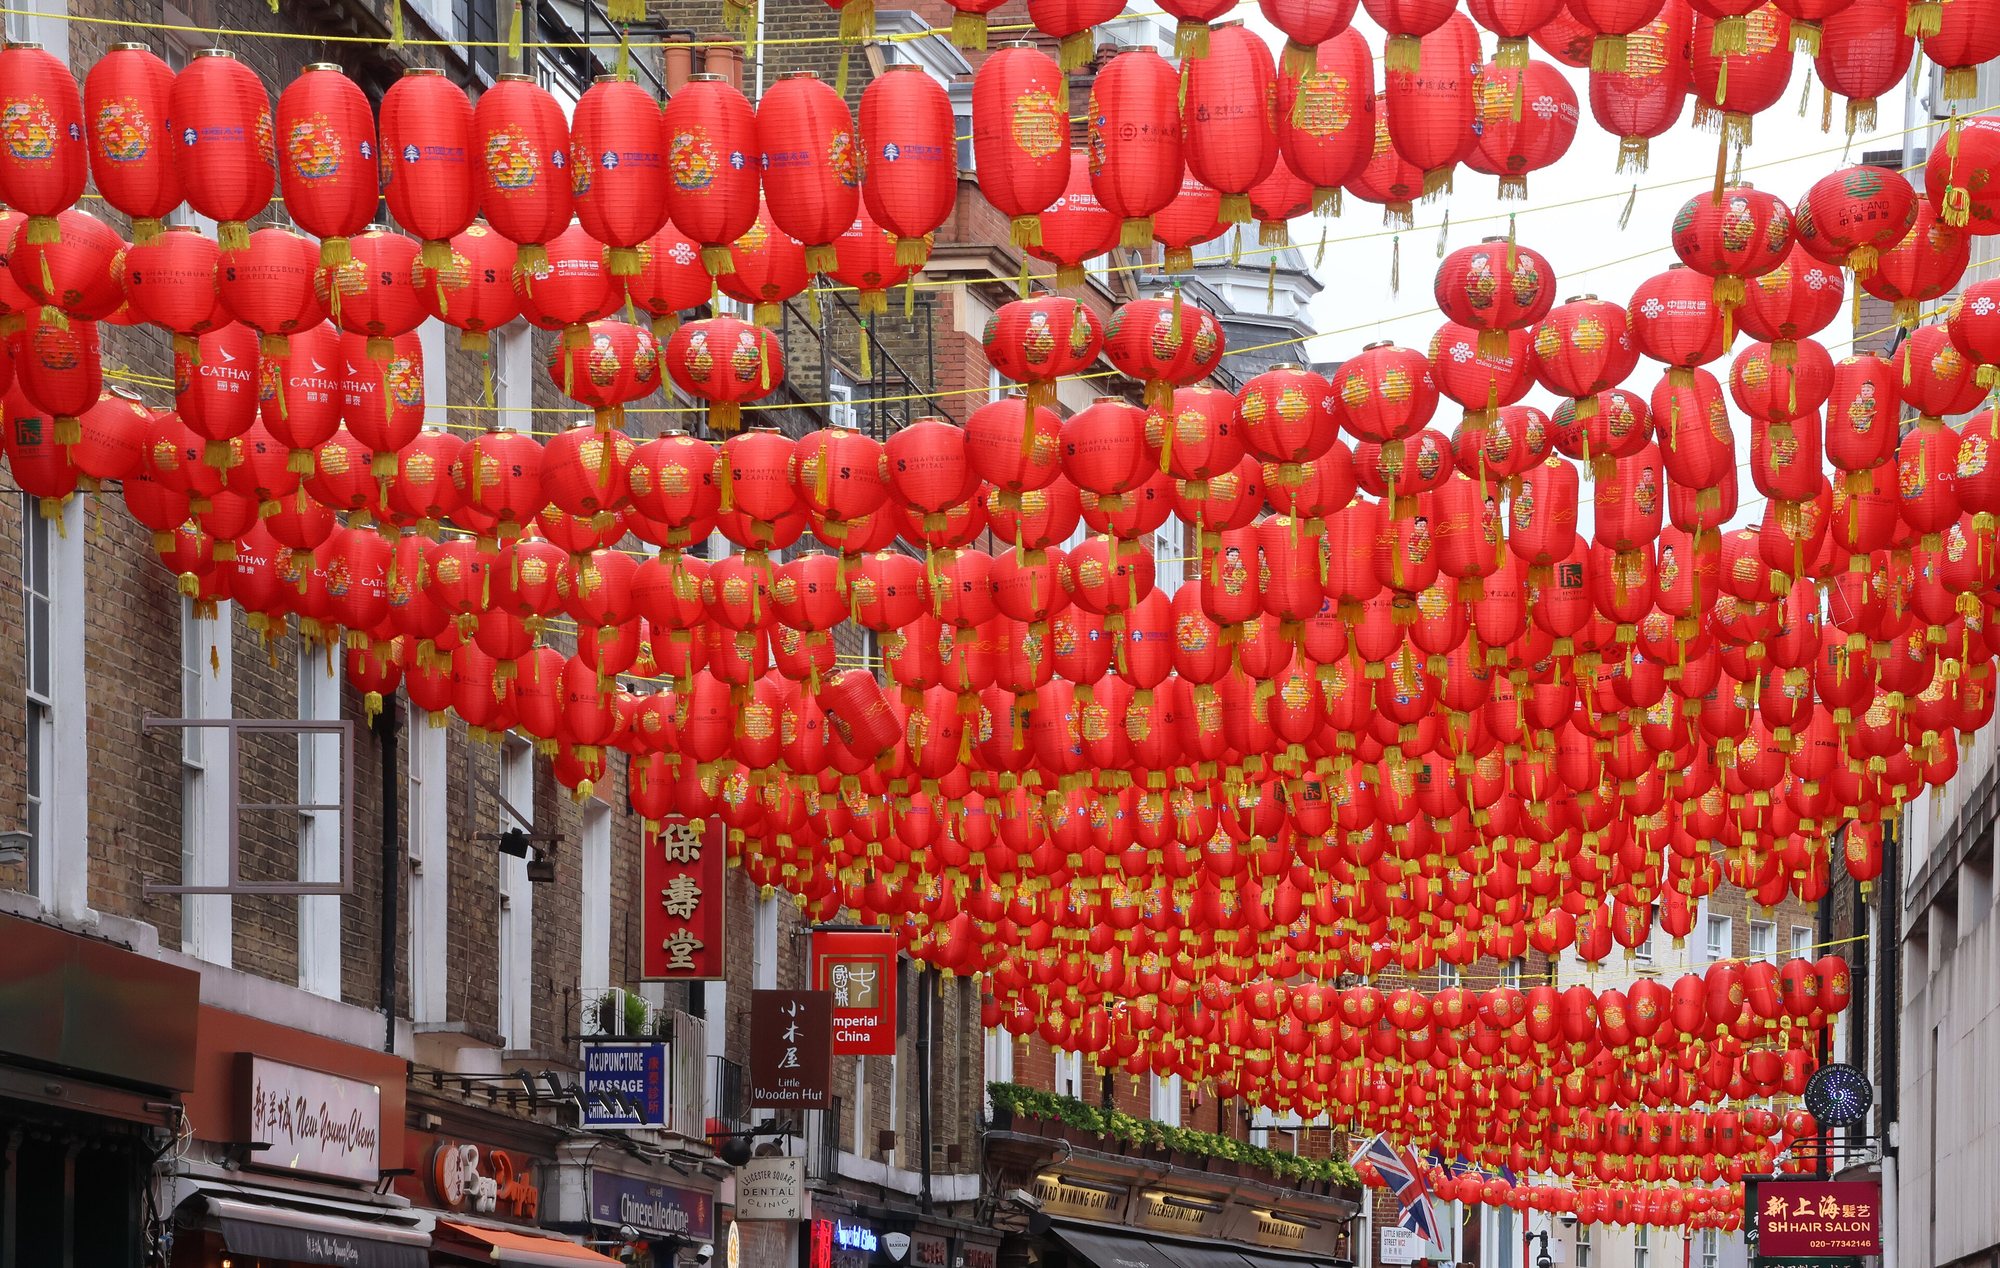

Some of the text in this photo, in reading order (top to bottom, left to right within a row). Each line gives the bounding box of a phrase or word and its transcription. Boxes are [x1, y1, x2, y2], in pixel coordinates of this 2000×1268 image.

[200, 364, 252, 381] CATHAY
[289, 376, 339, 391] CATHAY
[342, 381, 377, 394] ATHAY
[659, 823, 704, 969] 保壽堂
[833, 1016, 878, 1029] mperial
[778, 1000, 804, 1069] 小木屋
[836, 1030, 871, 1042] China
[588, 1052, 644, 1072] ACUPUNCTURE
[588, 1079, 644, 1093] MASSAGE
[778, 1077, 801, 1088] Little
[1838, 1065, 1857, 1076] HAIR
[1855, 1073, 1870, 1096] SALON
[755, 1087, 823, 1100] Wooden Hut
[296, 1095, 318, 1139] New
[320, 1101, 347, 1157] Young
[347, 1108, 376, 1162] Cheng
[741, 1170, 797, 1186] LEICESTER SQUARE
[743, 1188, 795, 1197] DENTAL
[1032, 1183, 1058, 1202] AWARD
[1059, 1187, 1091, 1208] WINNING
[1091, 1192, 1106, 1209] GAY
[747, 1198, 789, 1208] CLINIC
[621, 1192, 652, 1228] Chinese
[651, 1201, 690, 1234] Medicine
[1148, 1202, 1175, 1220] LICENSED
[1768, 1221, 1871, 1233] SH HAIR SALON
[1384, 1230, 1412, 1239] LITTLE NEWPORT
[1384, 1238, 1397, 1247] STREET
[1809, 1240, 1871, 1248] 020-77342146
